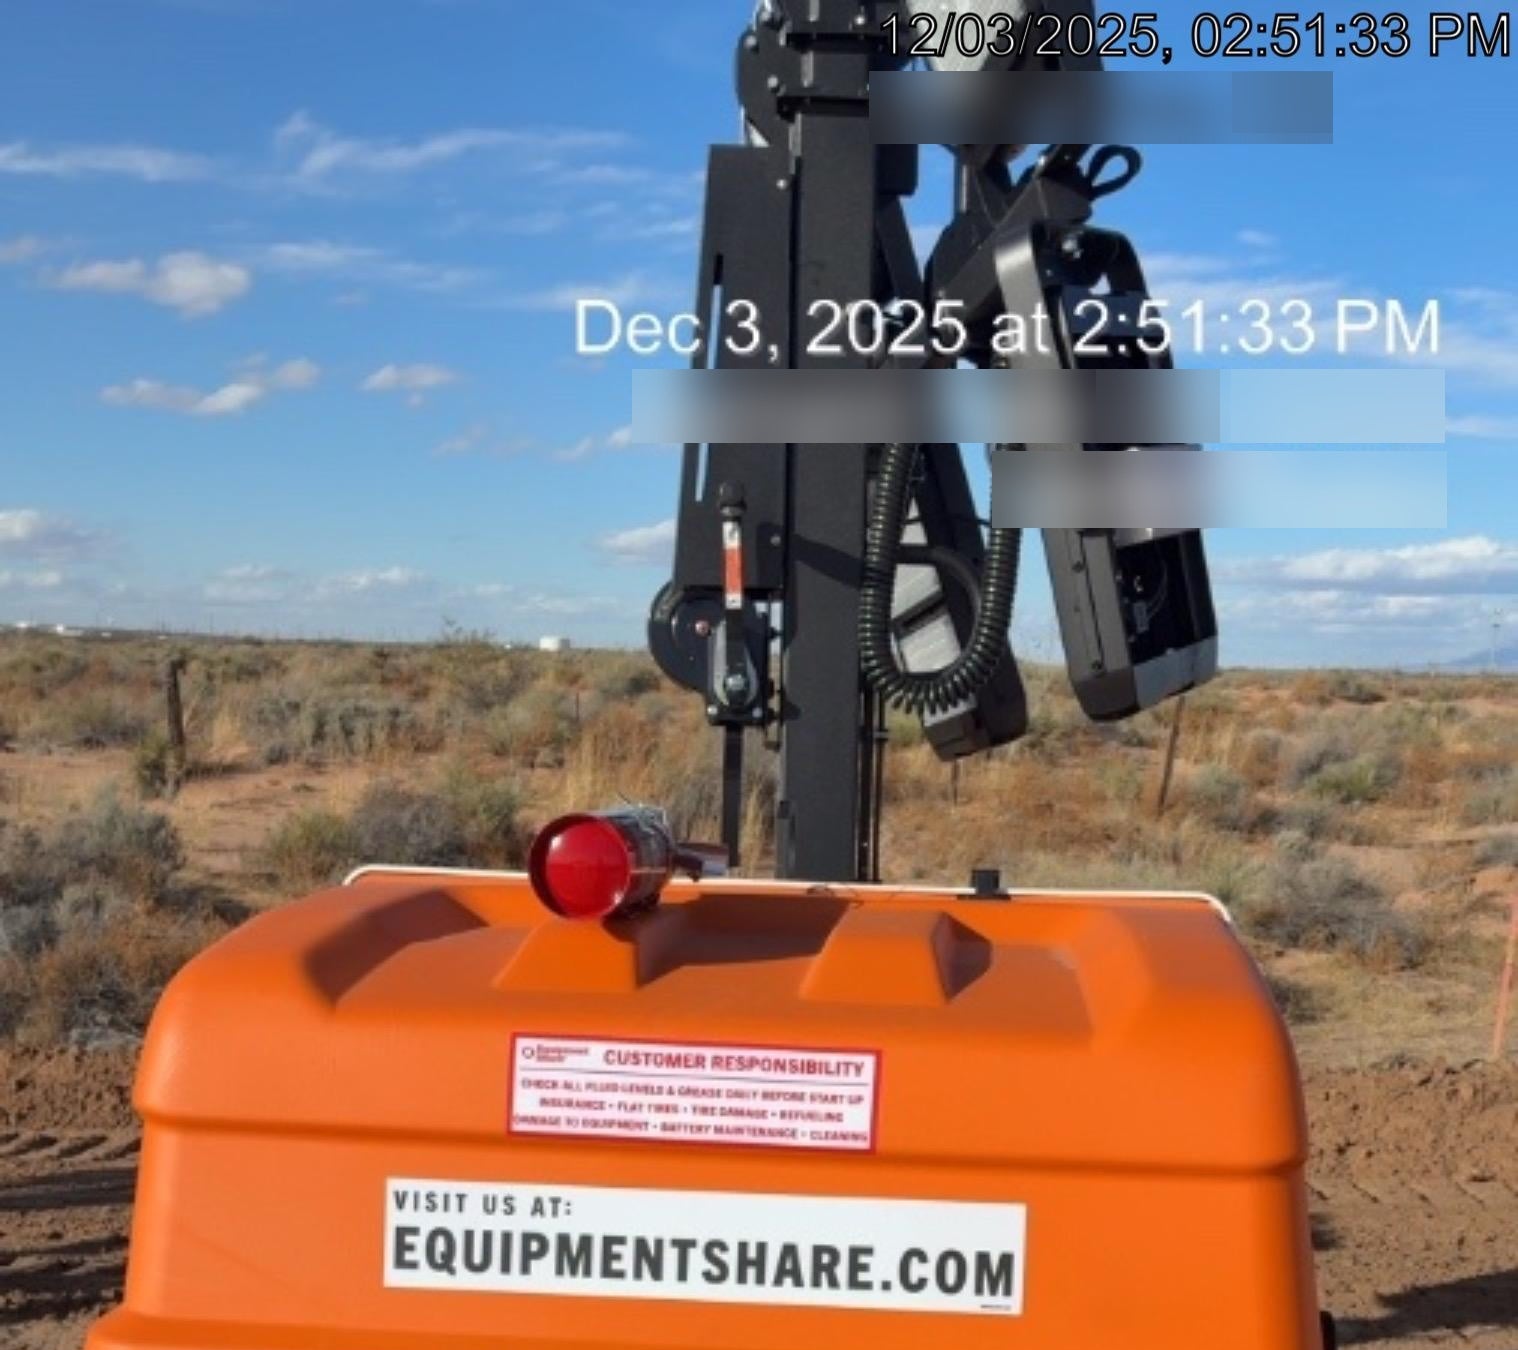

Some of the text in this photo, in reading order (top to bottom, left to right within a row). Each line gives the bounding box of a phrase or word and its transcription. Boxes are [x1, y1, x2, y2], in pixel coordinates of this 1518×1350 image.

[604, 1049, 864, 1078] CUSTOMER RESPONSIBILITY
[521, 1078, 559, 1091] CHECK
[563, 1080, 583, 1092] ALL
[585, 1082, 619, 1094] FLUID
[621, 1083, 664, 1096] LEVELS
[678, 1086, 722, 1099] GREASE
[726, 1088, 758, 1101] DAILY
[761, 1090, 805, 1102] BEFORE
[809, 1093, 845, 1104] START
[848, 1095, 865, 1105] UP
[539, 1097, 844, 1123] INSURANCE FLAT TIRES TIRE DAMAGE REFUELING
[515, 1115, 868, 1142] DAMAGE TO EQUIPMENT BATTERY MAINTENANCE CLEANING
[394, 1190, 573, 1219] VISIT US AT:
[392, 1225, 1016, 1298] EQUIPMENTSHARE.COM
